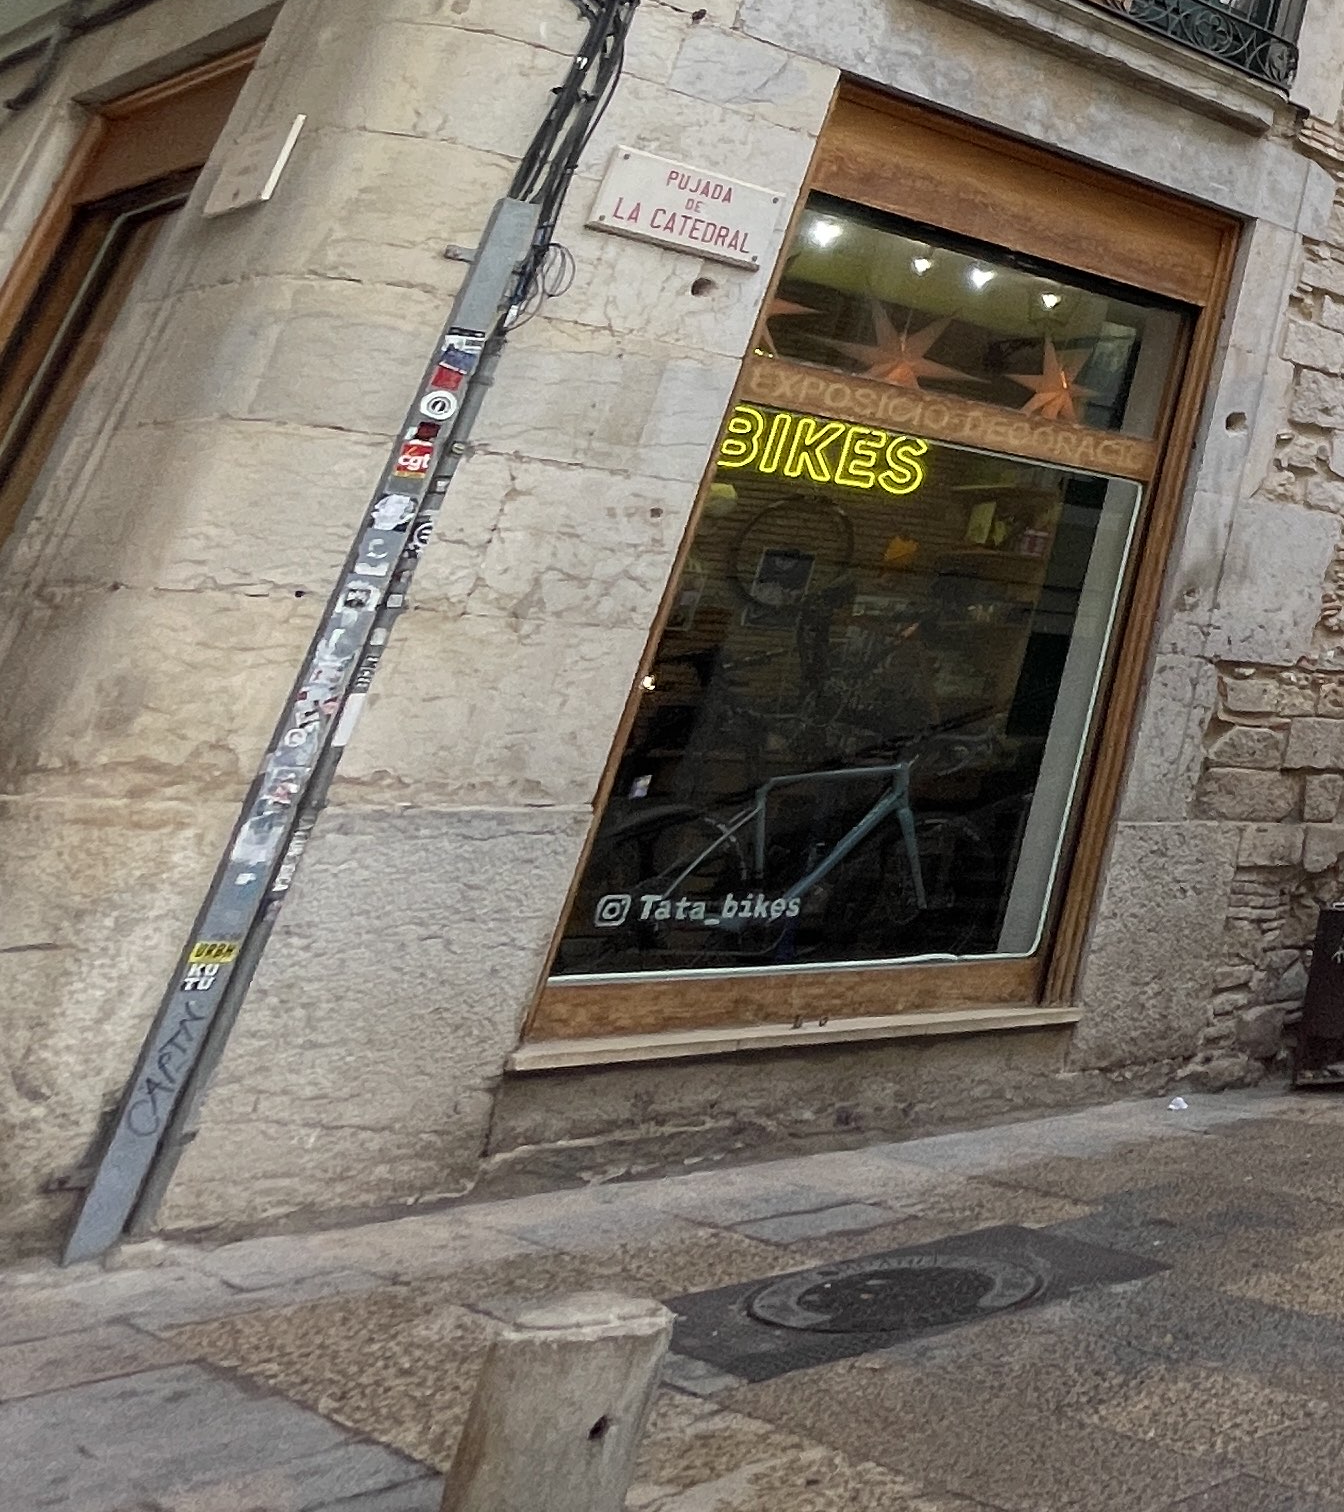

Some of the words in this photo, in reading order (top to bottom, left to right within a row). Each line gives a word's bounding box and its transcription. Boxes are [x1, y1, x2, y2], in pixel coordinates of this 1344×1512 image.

[666, 170, 734, 204] PUJADA
[685, 198, 705, 214] DE
[612, 197, 642, 224] LA
[649, 208, 750, 254] CATEDRAL
[397, 454, 432, 471] cgt
[716, 403, 929, 495] BIKES
[639, 891, 802, 926] Tata_bikes
